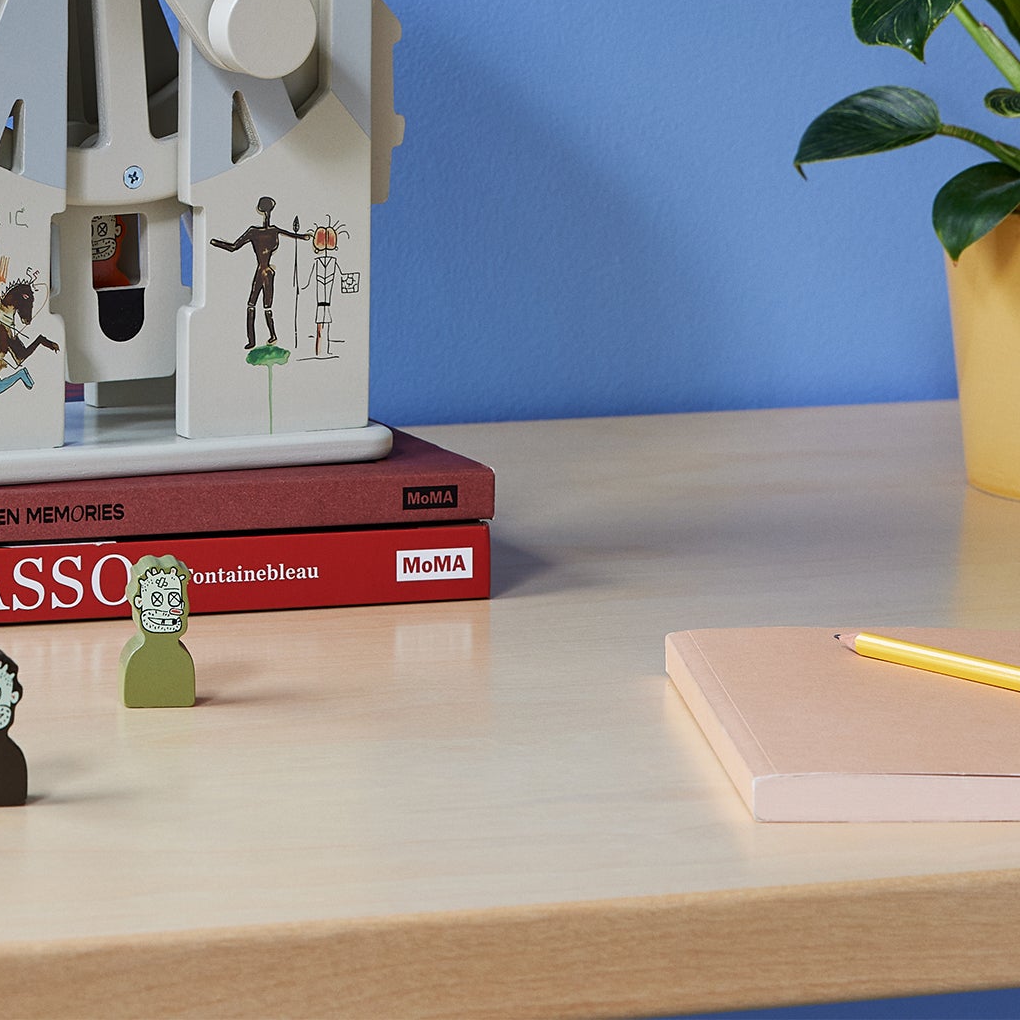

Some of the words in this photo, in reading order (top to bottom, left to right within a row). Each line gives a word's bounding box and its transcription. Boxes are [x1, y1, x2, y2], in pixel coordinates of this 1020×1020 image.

[407, 490, 454, 505] MoMA
[26, 502, 125, 525] MEMORIES
[188, 563, 319, 585] ontainebleau
[402, 554, 467, 574] MoMA
